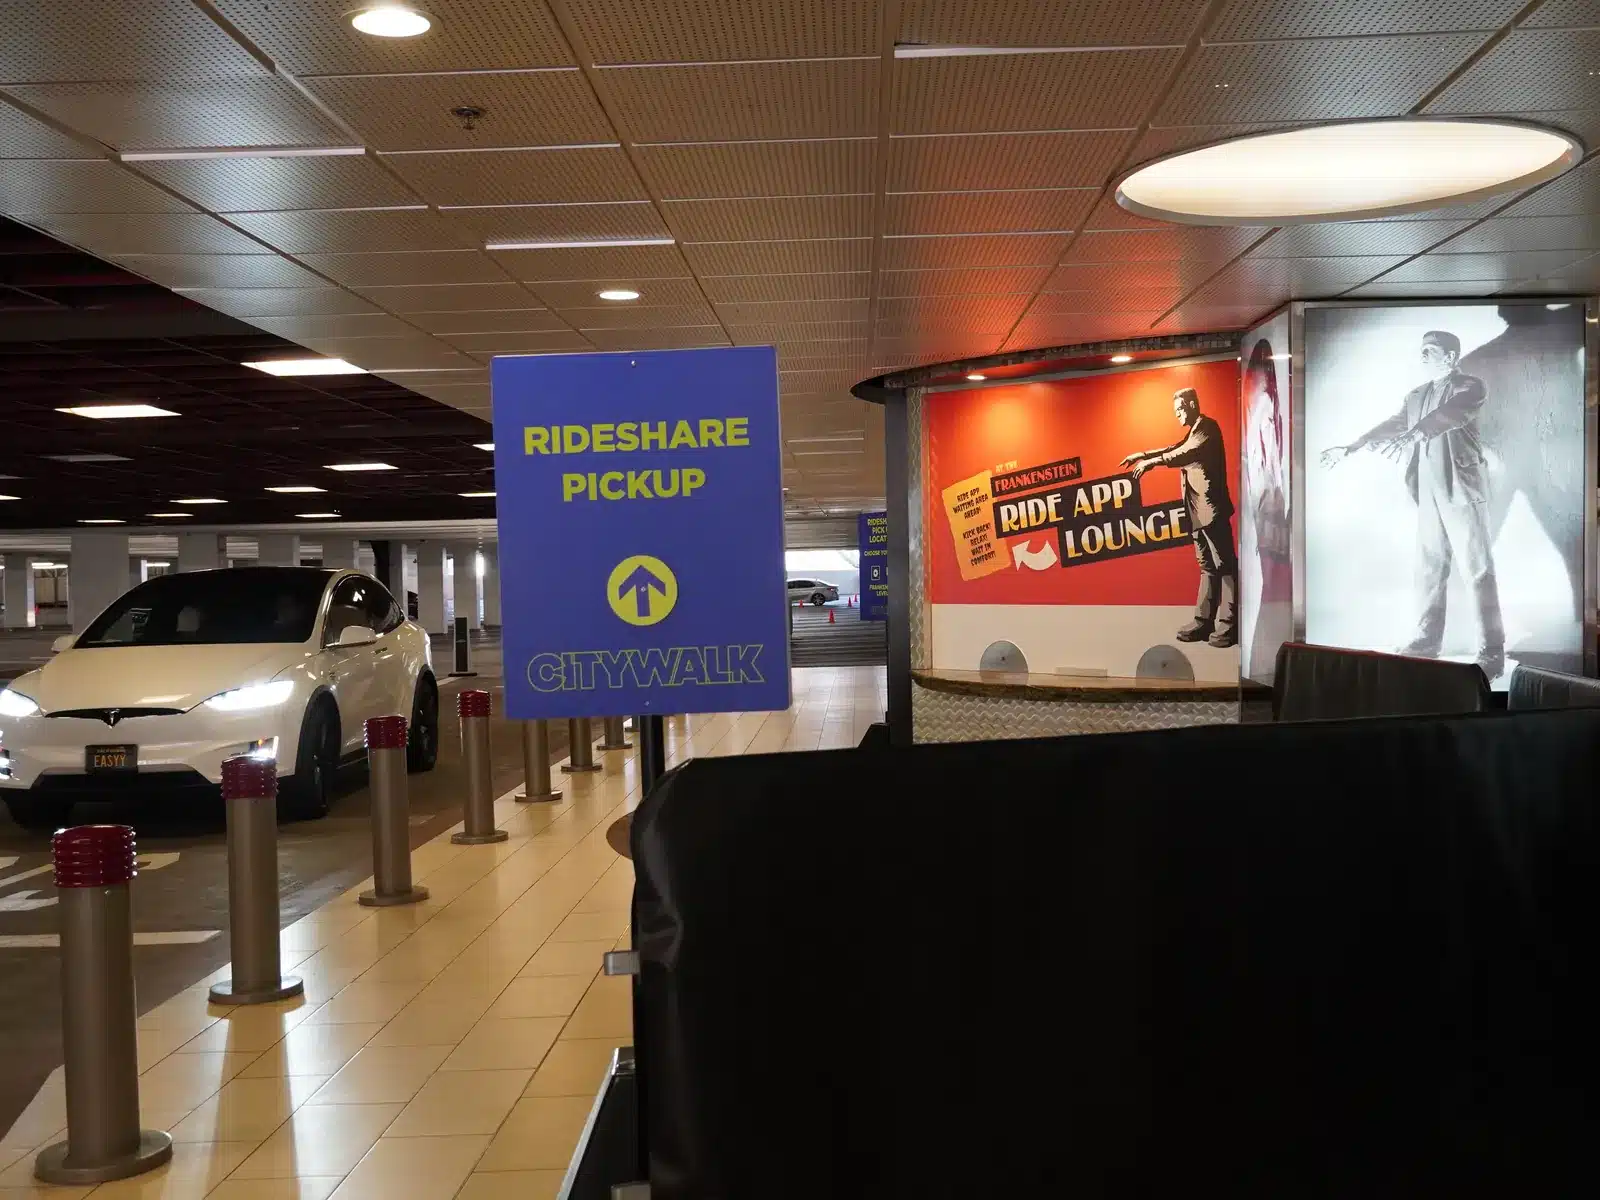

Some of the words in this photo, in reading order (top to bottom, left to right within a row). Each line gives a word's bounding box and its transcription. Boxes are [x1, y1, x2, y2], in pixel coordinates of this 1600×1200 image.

[524, 417, 750, 455] RIDESHARE
[562, 468, 706, 502] PICKUP
[994, 462, 1078, 492] FRANKENSTEIN
[953, 499, 974, 514] WAITING
[976, 493, 989, 505] AREA
[957, 491, 969, 502] RIDE
[970, 487, 979, 497] APP
[1000, 493, 1063, 532] RIDE
[1073, 479, 1133, 518] APP
[867, 517, 888, 526] RIDESH
[872, 526, 885, 534] PICK
[869, 534, 888, 543] LOCAT
[963, 528, 975, 540] KICK
[1065, 507, 1189, 559] LOUNGE
[971, 545, 983, 556] WAIT
[985, 542, 991, 551] IN
[527, 644, 765, 692] CITYWALK
[94, 754, 126, 768] EASYY
